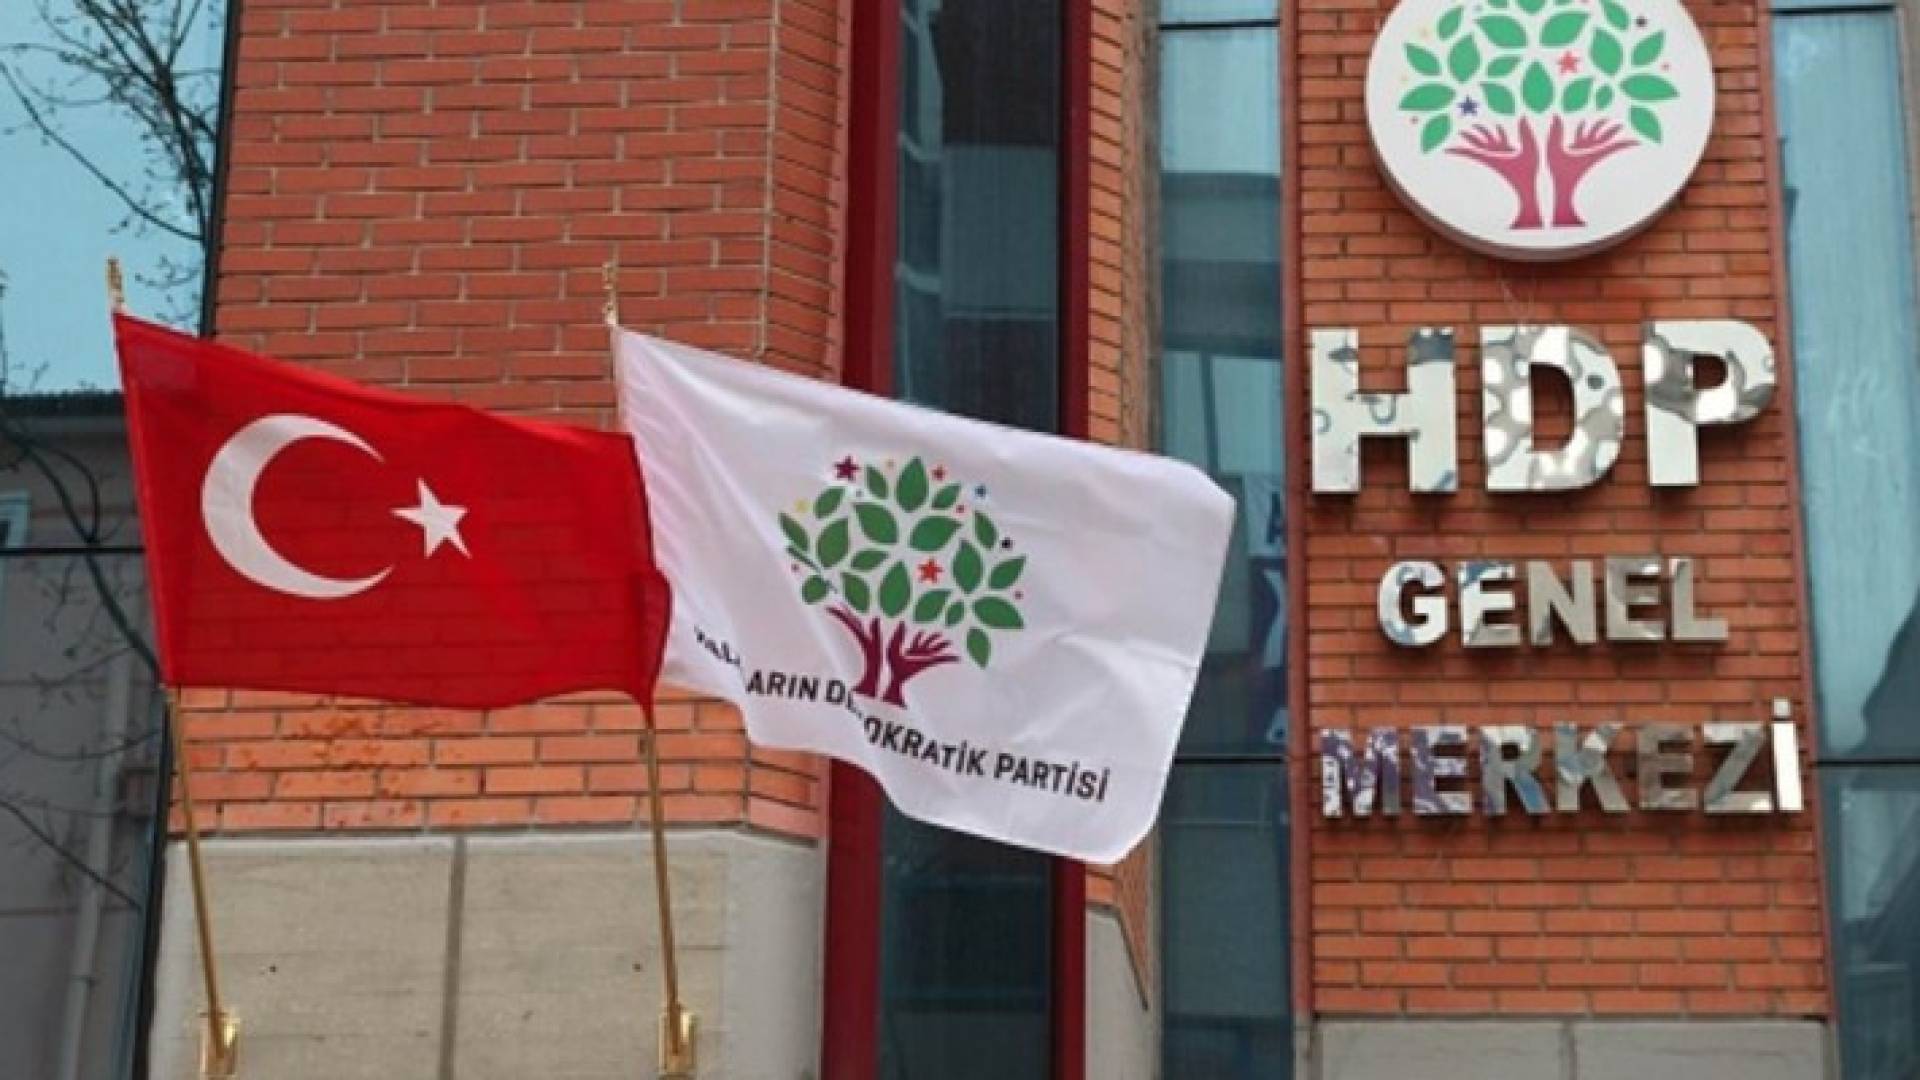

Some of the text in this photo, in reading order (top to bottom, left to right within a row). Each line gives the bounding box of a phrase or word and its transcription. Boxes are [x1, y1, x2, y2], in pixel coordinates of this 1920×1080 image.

[1311, 320, 1776, 494] HDP
[1377, 556, 1729, 648] GENEL
[824, 679, 988, 776] DOKRATİK
[993, 752, 1111, 803] PARTİSİ
[1320, 697, 1804, 818] MERKEZİ
